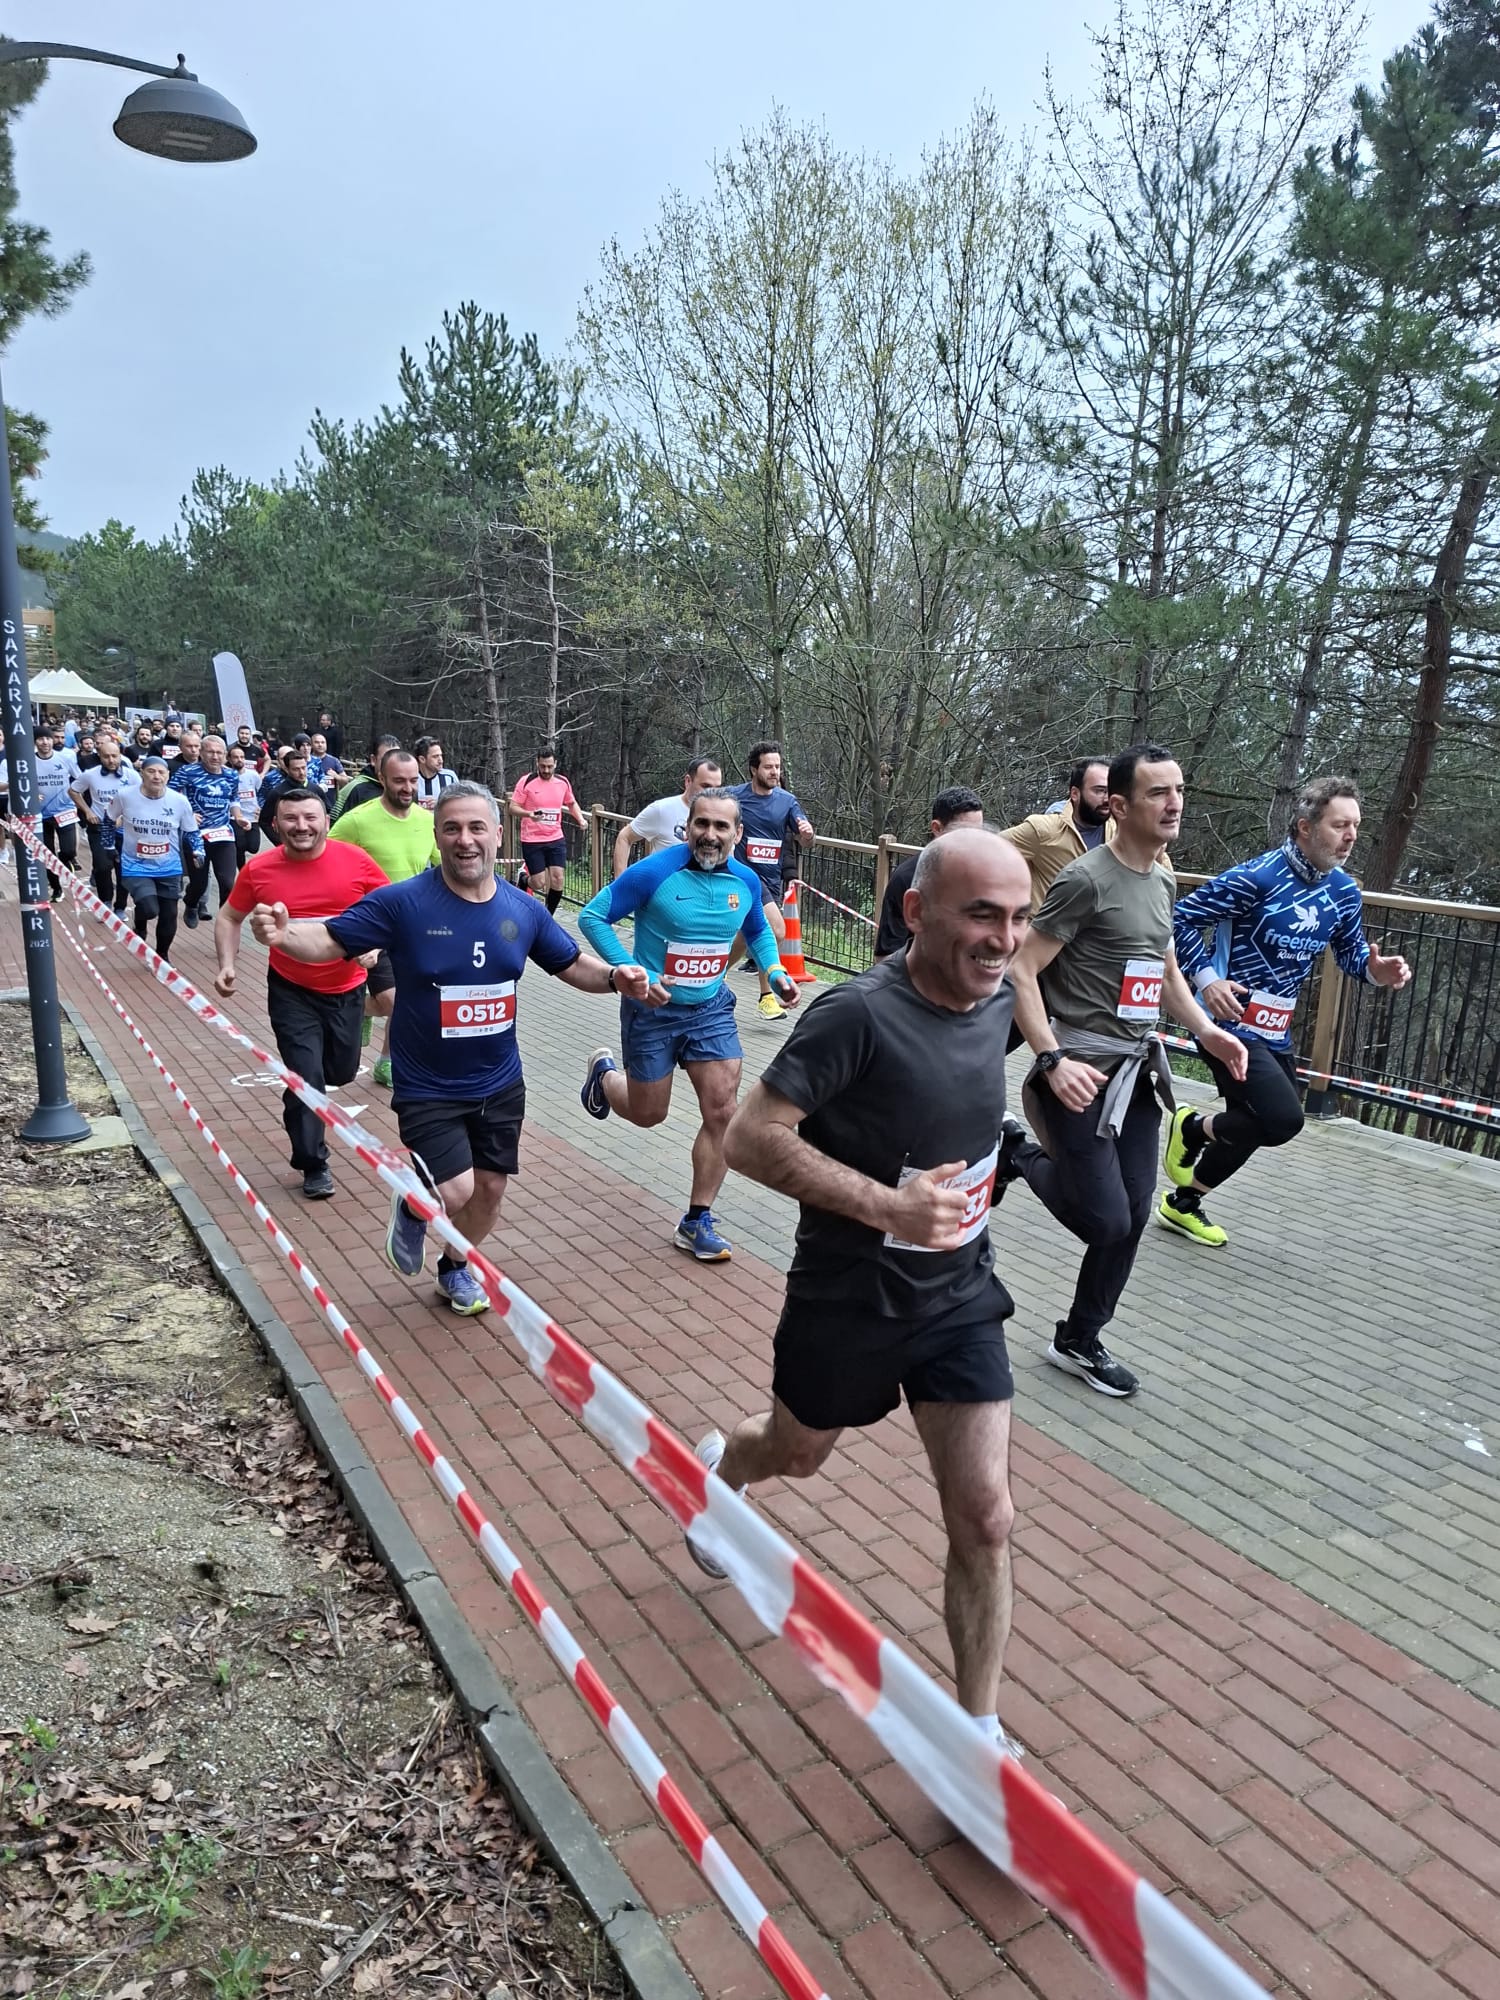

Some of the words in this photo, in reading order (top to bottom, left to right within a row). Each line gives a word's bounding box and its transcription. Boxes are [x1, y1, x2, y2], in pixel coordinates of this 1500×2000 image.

[3, 619, 27, 735] SAKARYA
[16, 760, 44, 930] BÜYŞEHİR
[132, 817, 173, 828] FreeSteps
[752, 846, 776, 858] 0476
[472, 941, 486, 968] 5
[674, 958, 722, 975] 0506
[456, 1001, 506, 1023] 0512
[1255, 1009, 1290, 1029] 0541
